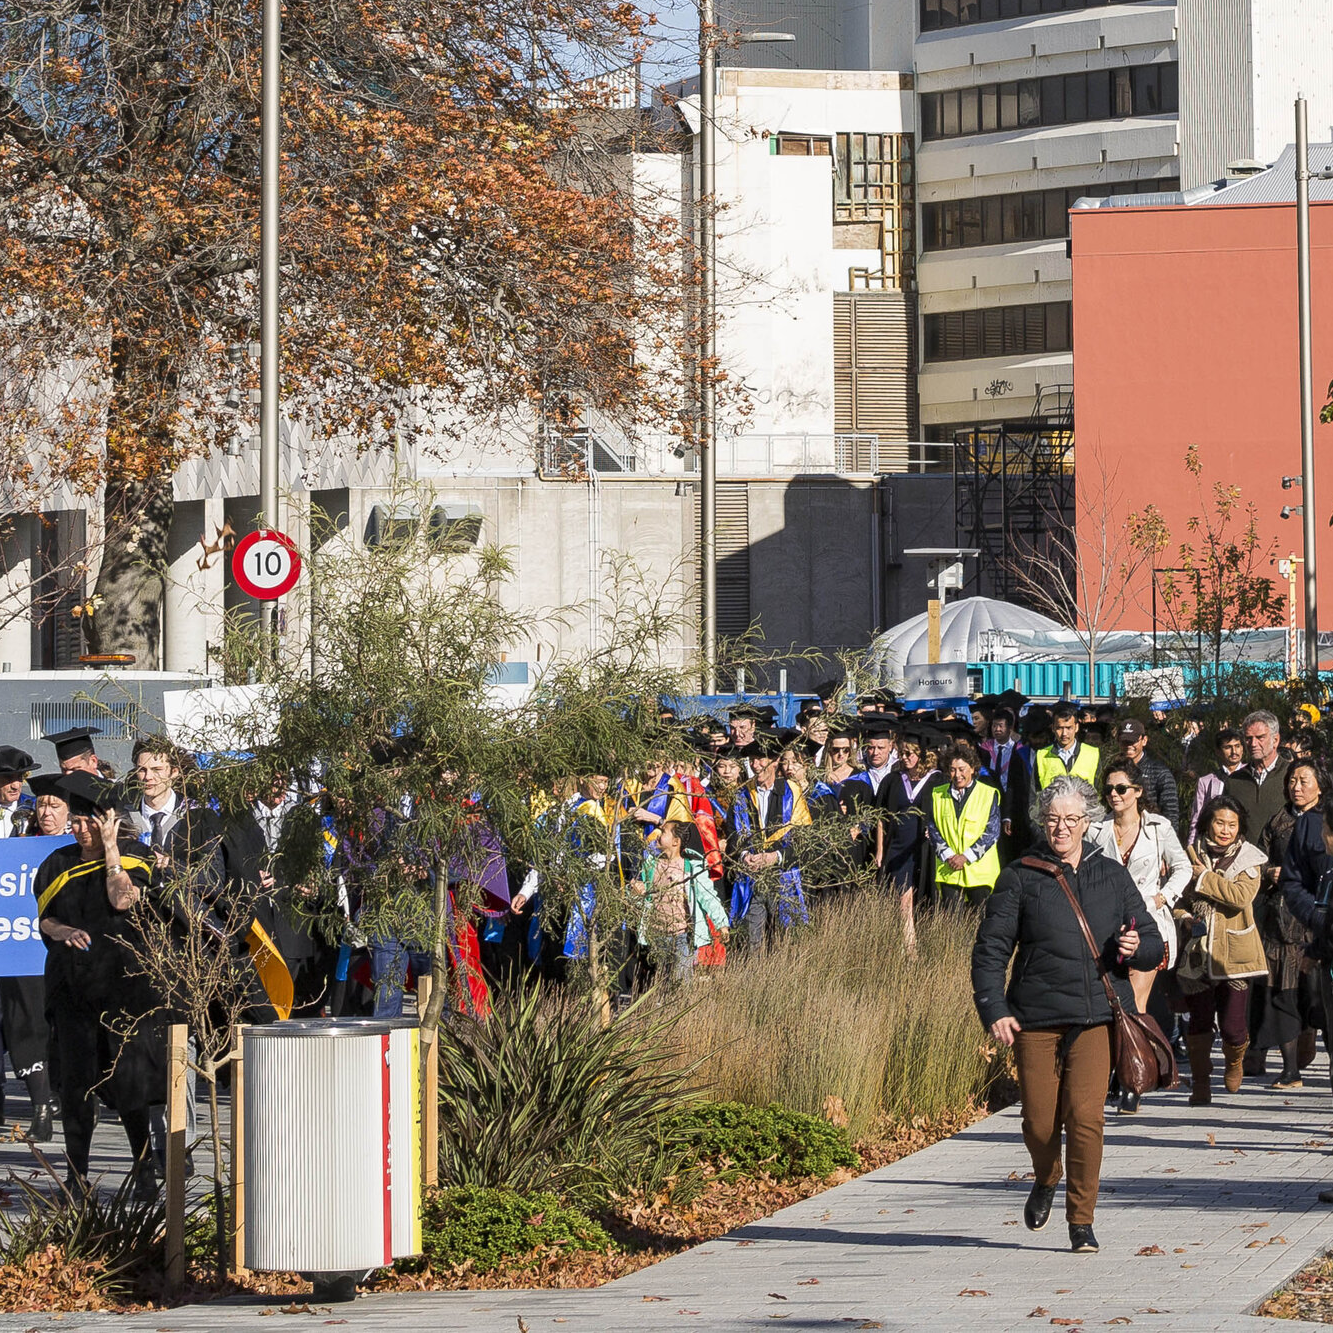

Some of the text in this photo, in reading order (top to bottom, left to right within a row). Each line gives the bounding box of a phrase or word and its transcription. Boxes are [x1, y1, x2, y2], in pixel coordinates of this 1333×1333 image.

[254, 551, 282, 576] 10
[918, 678, 953, 687] Honours
[204, 713, 236, 727] PhD'
